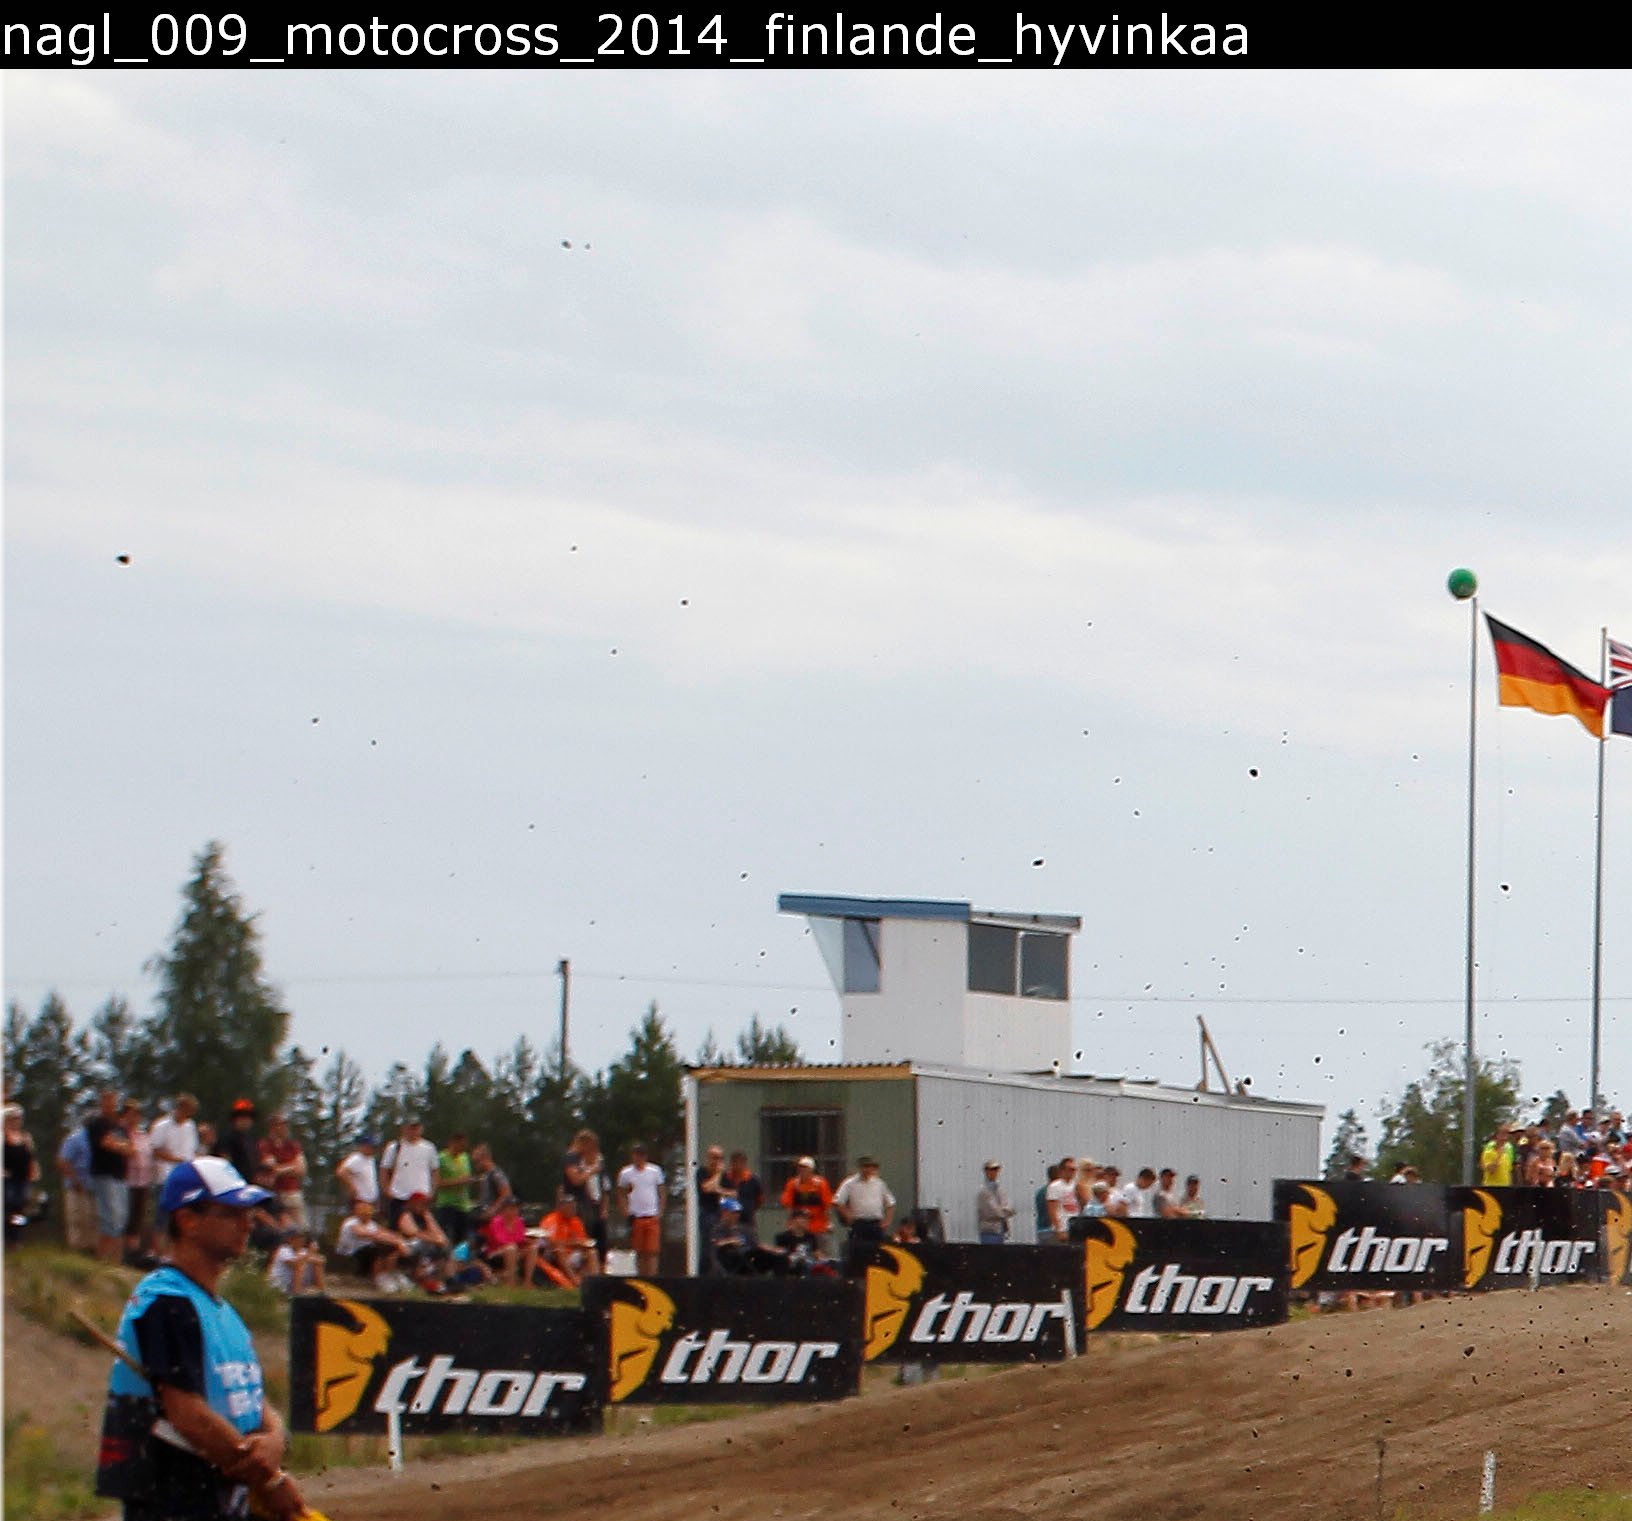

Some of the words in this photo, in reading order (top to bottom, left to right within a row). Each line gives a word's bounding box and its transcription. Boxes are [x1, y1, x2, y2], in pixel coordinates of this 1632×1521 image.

[1327, 1226, 1450, 1273] thor
[1494, 1229, 1596, 1275] thor
[1124, 1263, 1273, 1315] thor
[910, 1291, 1070, 1343] thor
[661, 1329, 840, 1384] thor
[374, 1355, 587, 1417] thor
